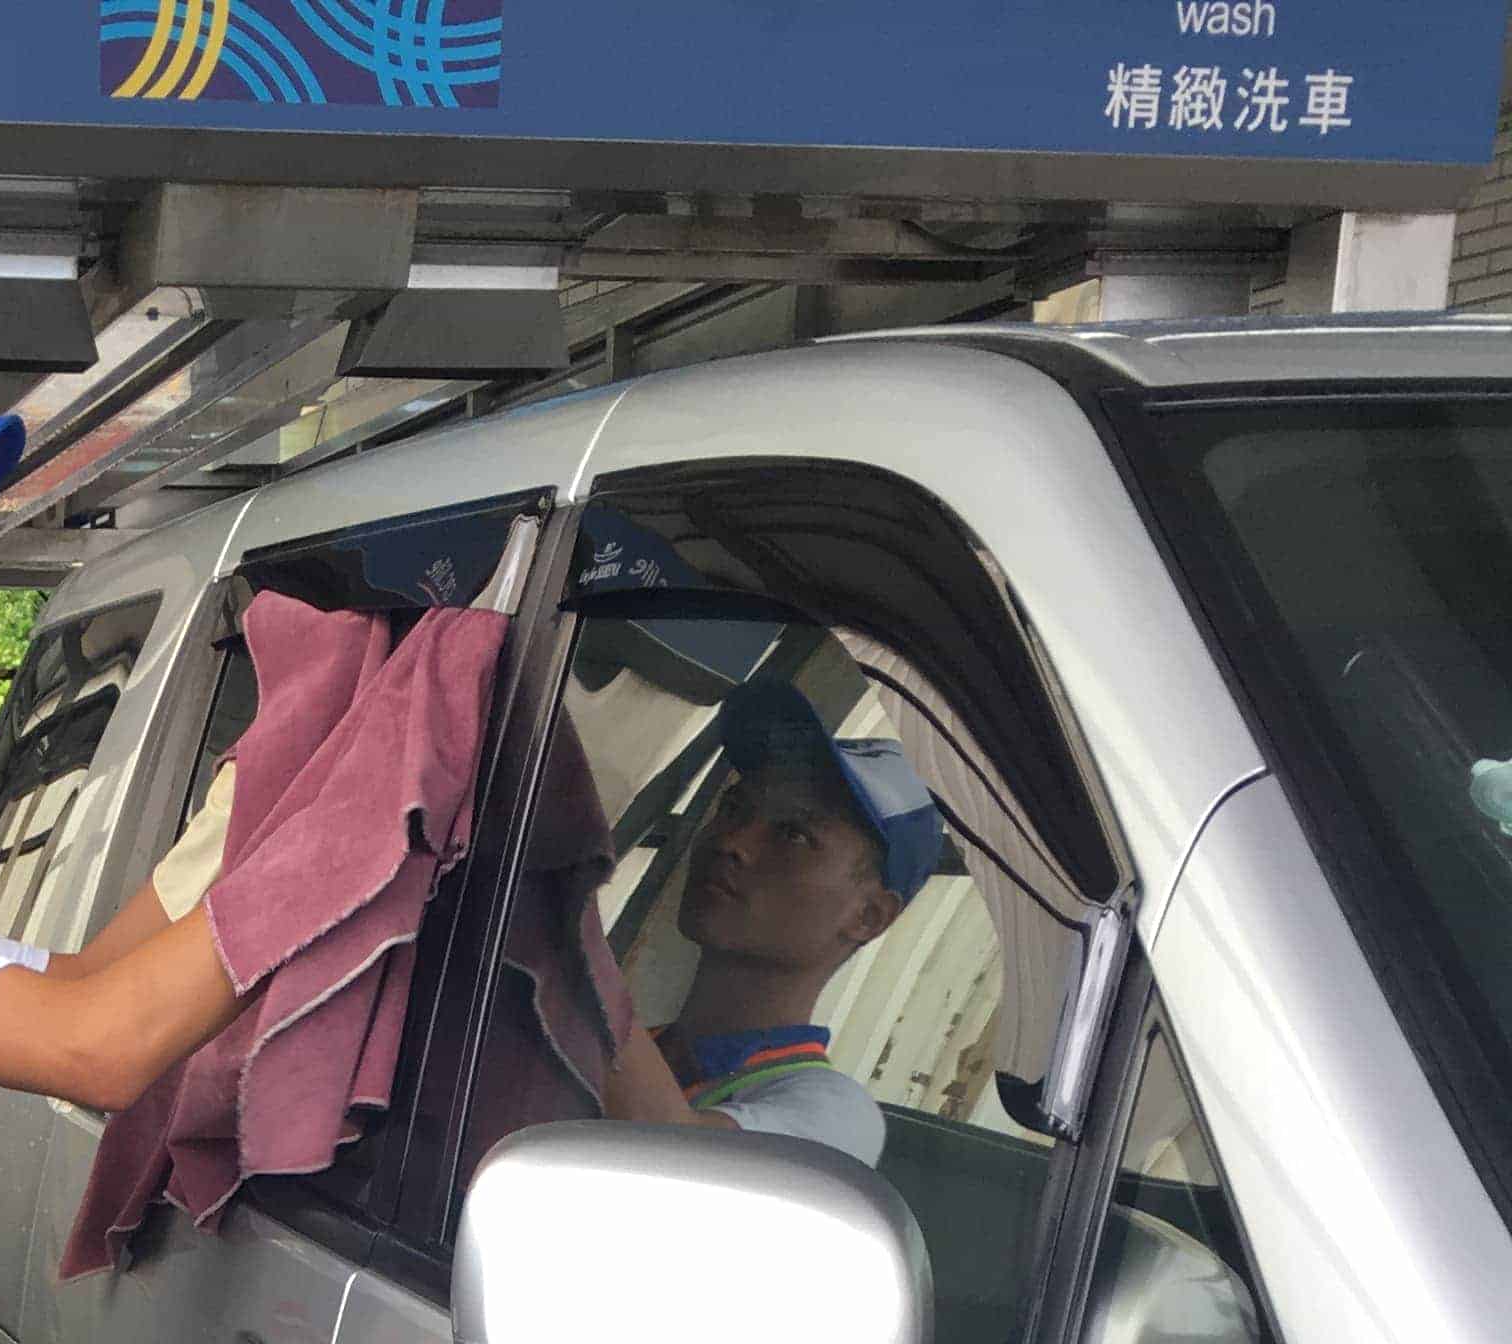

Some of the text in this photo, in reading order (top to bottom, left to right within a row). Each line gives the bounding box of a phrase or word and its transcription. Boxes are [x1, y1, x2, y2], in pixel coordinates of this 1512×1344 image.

[1176, 0, 1275, 37] wash
[1104, 61, 1354, 136] 精緻洗車
